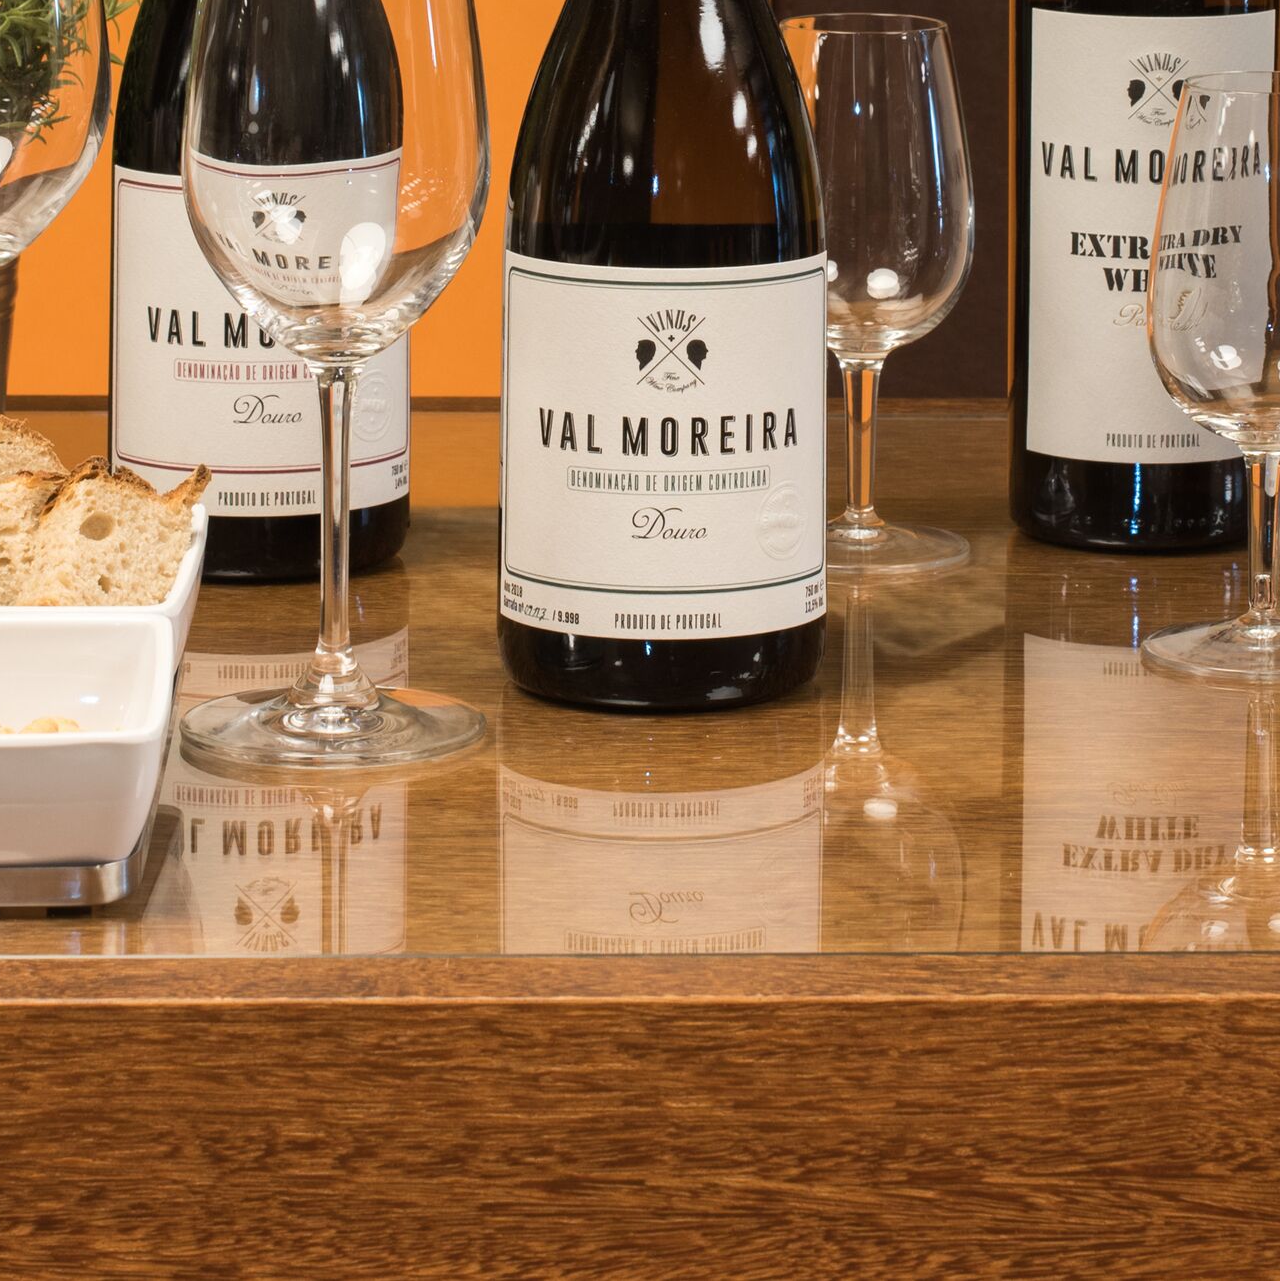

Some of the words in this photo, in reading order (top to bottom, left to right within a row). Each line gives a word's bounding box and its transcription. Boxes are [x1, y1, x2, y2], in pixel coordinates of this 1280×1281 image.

[1137, 53, 1181, 73] VINUS
[1042, 141, 1097, 182] VAL
[1192, 225, 1242, 247] DRY
[147, 306, 206, 347] VAL
[646, 309, 697, 332] VINUS
[177, 361, 240, 381] DENOMINAÇÃO
[245, 365, 257, 380] DE
[262, 364, 298, 380] ORIGEM
[233, 394, 303, 424] Douro
[539, 407, 603, 455] VAL
[622, 408, 799, 457] MOREIRA
[1106, 432, 1144, 448] PRODUTO
[1147, 433, 1157, 447] DE
[1160, 432, 1200, 447] PORTUGAL
[570, 469, 640, 492] DENOMINAÇÃO
[646, 475, 658, 492] DE
[663, 474, 704, 492] ORIGEM
[708, 469, 768, 491] CONTROLADA
[218, 491, 257, 507] PRODUTO
[260, 492, 271, 506] DE
[274, 489, 316, 506] PORTUGAL
[631, 506, 708, 541] Douro
[614, 614, 656, 630] PRODUTO
[660, 615, 671, 630] DE
[675, 613, 722, 629] PORTUGAL
